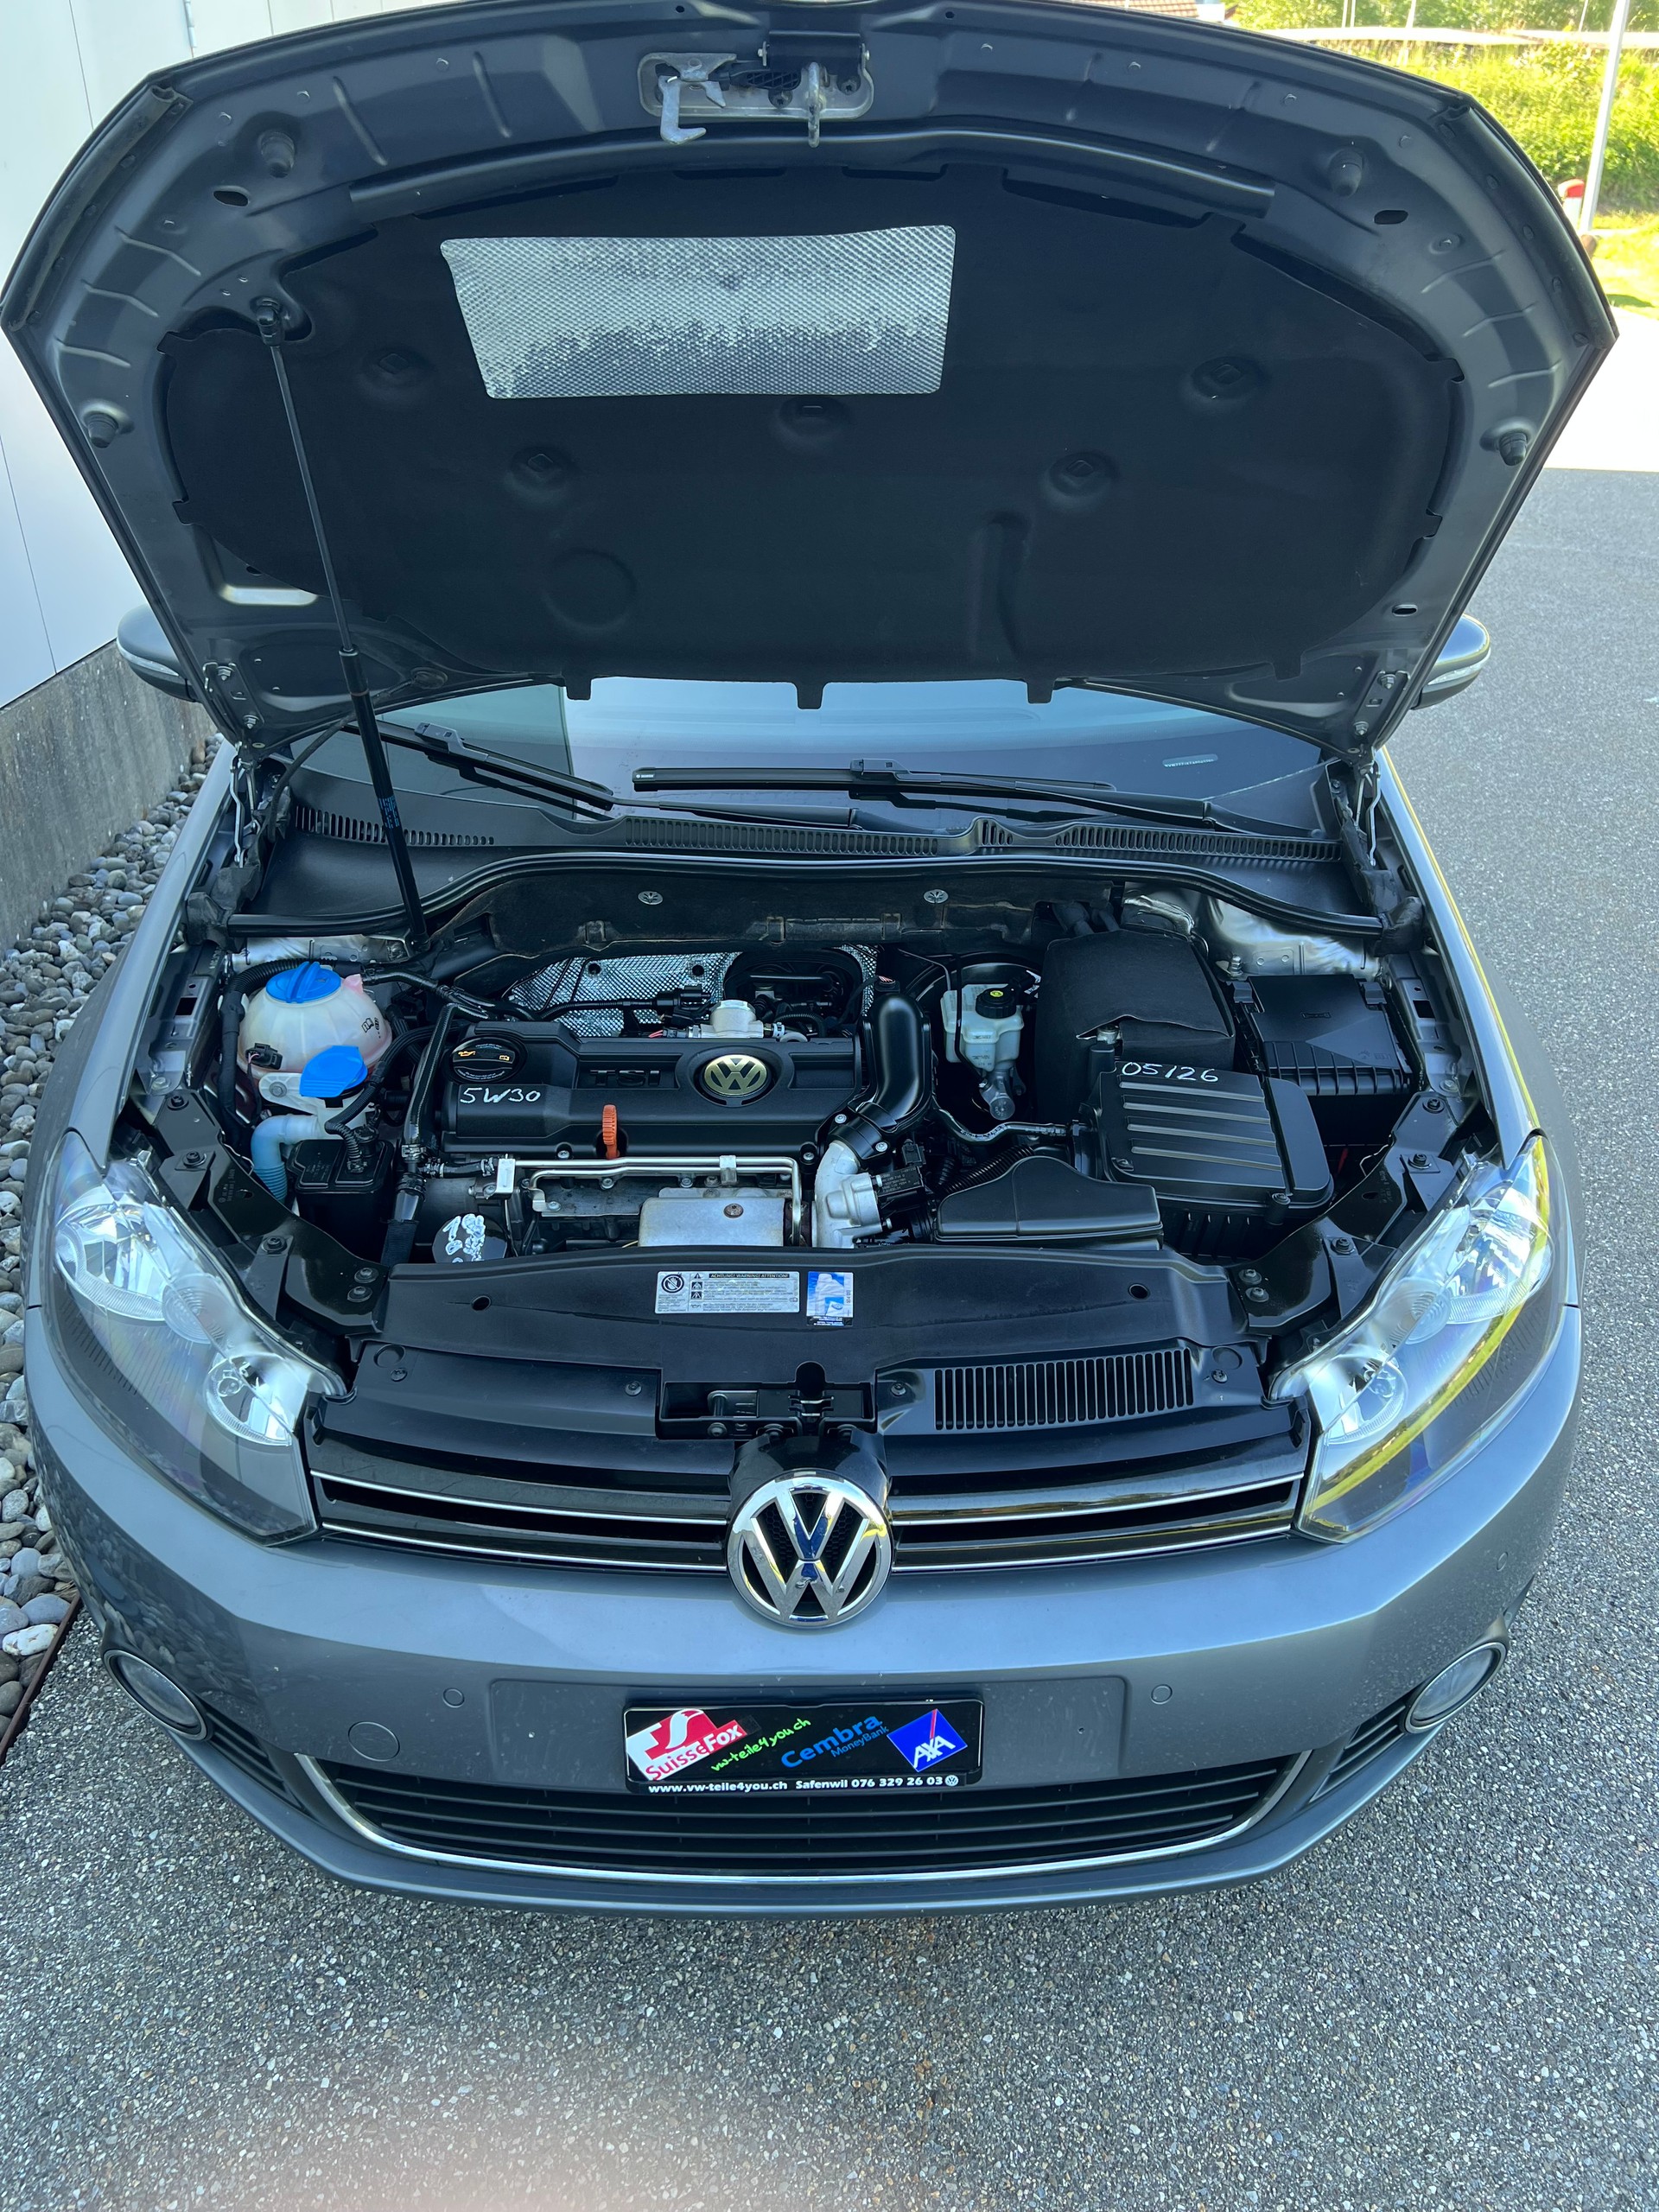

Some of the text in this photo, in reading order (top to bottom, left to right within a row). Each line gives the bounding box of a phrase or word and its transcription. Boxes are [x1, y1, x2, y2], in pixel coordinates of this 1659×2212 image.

[589, 1069, 661, 1087] TSI
[1122, 1061, 1219, 1083] 05/26
[460, 1087, 542, 1104] 5W30
[780, 1715, 883, 1769] Cembra
[830, 1725, 890, 1758] MoneyBank
[912, 1735, 957, 1770] AXA
[648, 1780, 788, 1794] www.vw-teile4you.ch
[795, 1780, 849, 1790] Safenwil
[851, 1778, 876, 1789] 076
[879, 1777, 904, 1788] 329
[906, 1777, 924, 1787] 26
[926, 1776, 944, 1786] 03
